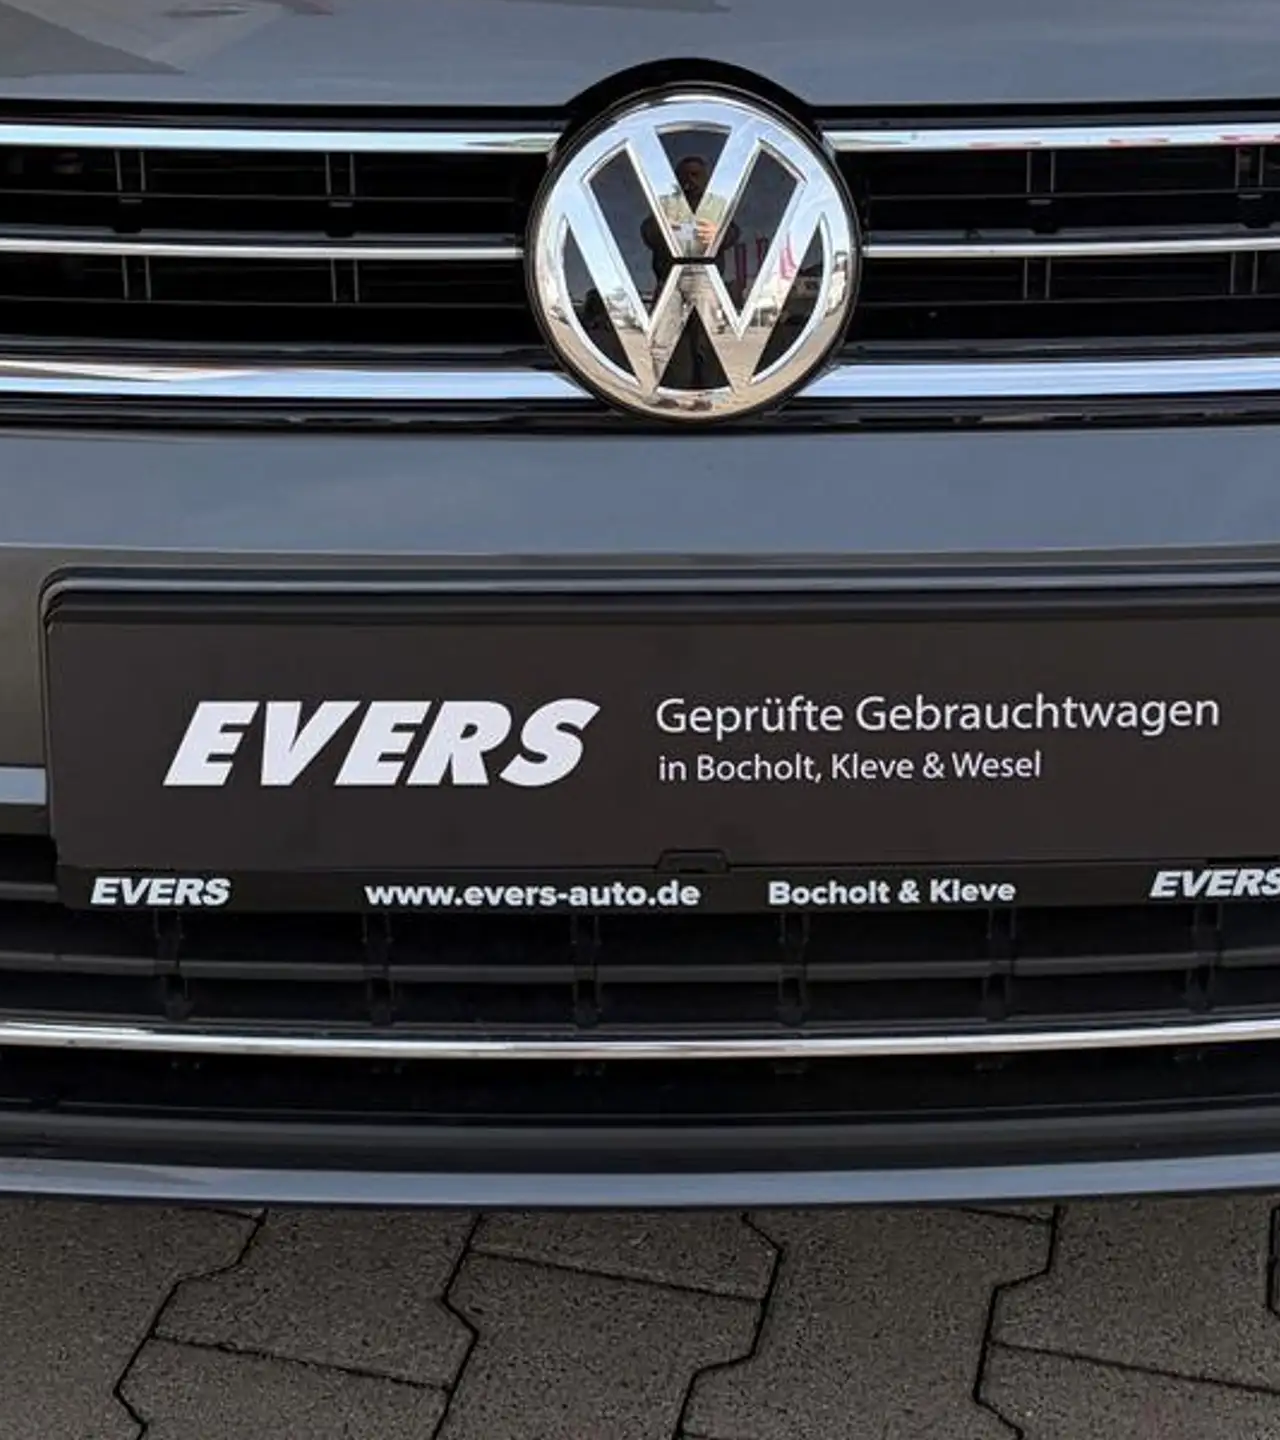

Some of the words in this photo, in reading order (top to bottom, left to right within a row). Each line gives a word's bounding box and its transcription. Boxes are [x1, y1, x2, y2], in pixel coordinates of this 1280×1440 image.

[656, 694, 844, 742] Geprüfte
[855, 692, 1219, 737] Gebrauchtwagen
[162, 698, 601, 787] EVERS
[659, 755, 687, 781] in
[697, 752, 822, 784] Bocholt,
[831, 752, 915, 780] Kleve
[922, 751, 945, 779] &
[951, 749, 1041, 778] Wesel
[90, 877, 231, 906] EVERS
[364, 879, 701, 907] www.evers-auto.de
[768, 880, 891, 905] Bocholt
[897, 879, 920, 904] &
[930, 878, 1016, 903] Kleve
